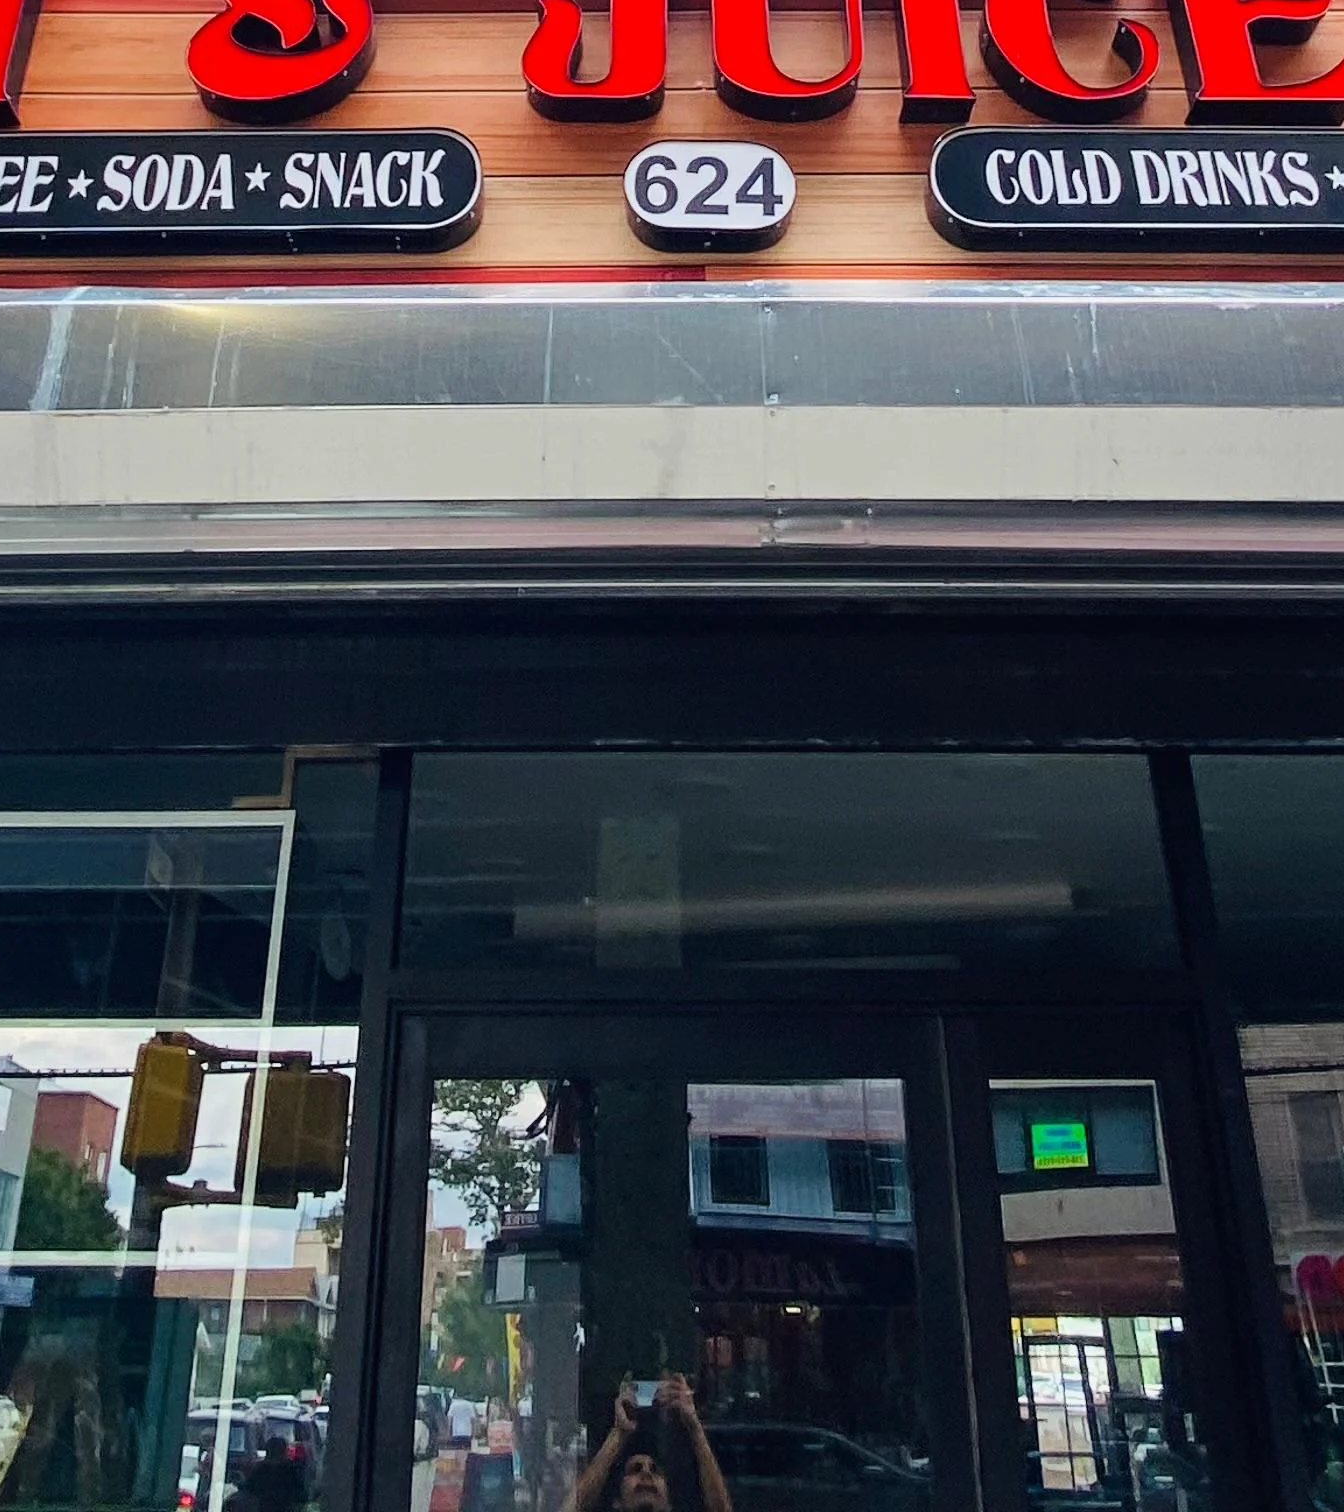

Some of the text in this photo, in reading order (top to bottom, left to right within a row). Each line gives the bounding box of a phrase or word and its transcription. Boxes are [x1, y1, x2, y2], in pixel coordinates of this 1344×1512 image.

[96, 153, 235, 212] SODA
[279, 149, 446, 210] SNACK
[633, 154, 785, 216] 624
[985, 149, 1122, 206] COLD
[1130, 150, 1320, 207] DRINKS
